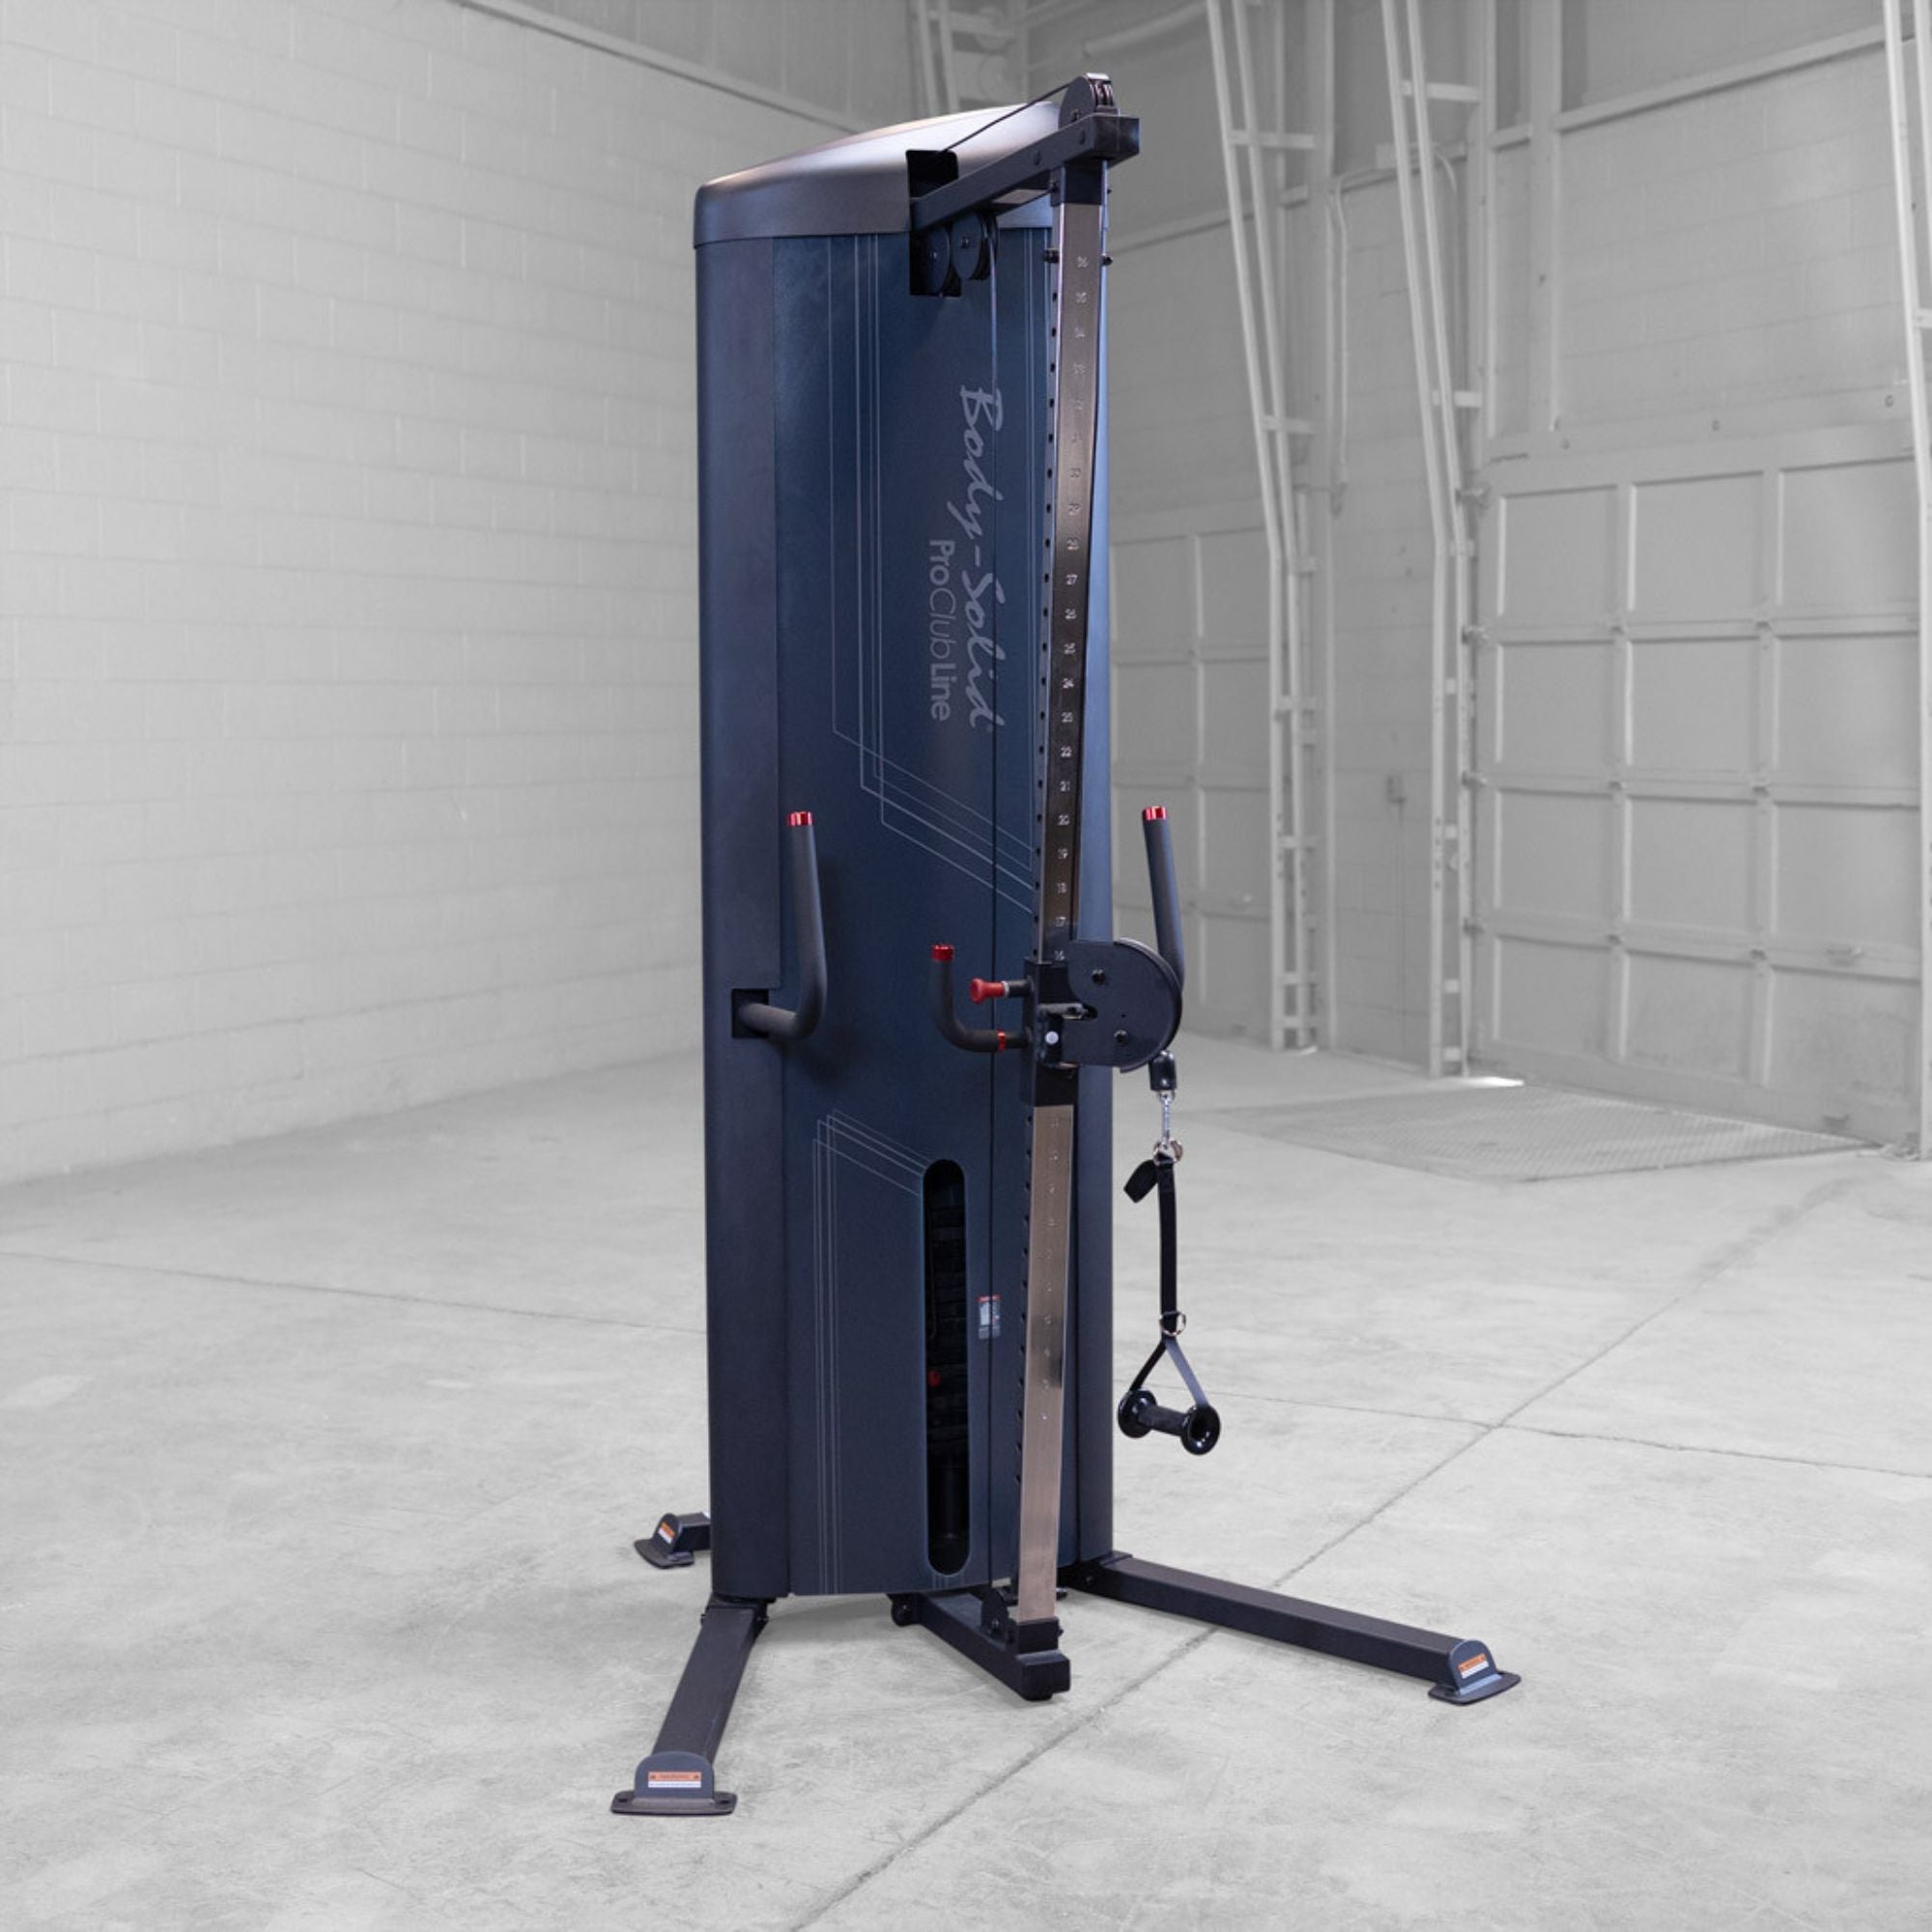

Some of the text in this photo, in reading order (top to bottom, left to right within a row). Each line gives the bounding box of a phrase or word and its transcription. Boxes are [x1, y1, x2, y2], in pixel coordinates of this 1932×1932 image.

[1061, 745, 1072, 757] 22
[1060, 780, 1070, 792] 21
[1058, 814, 1070, 826] 20
